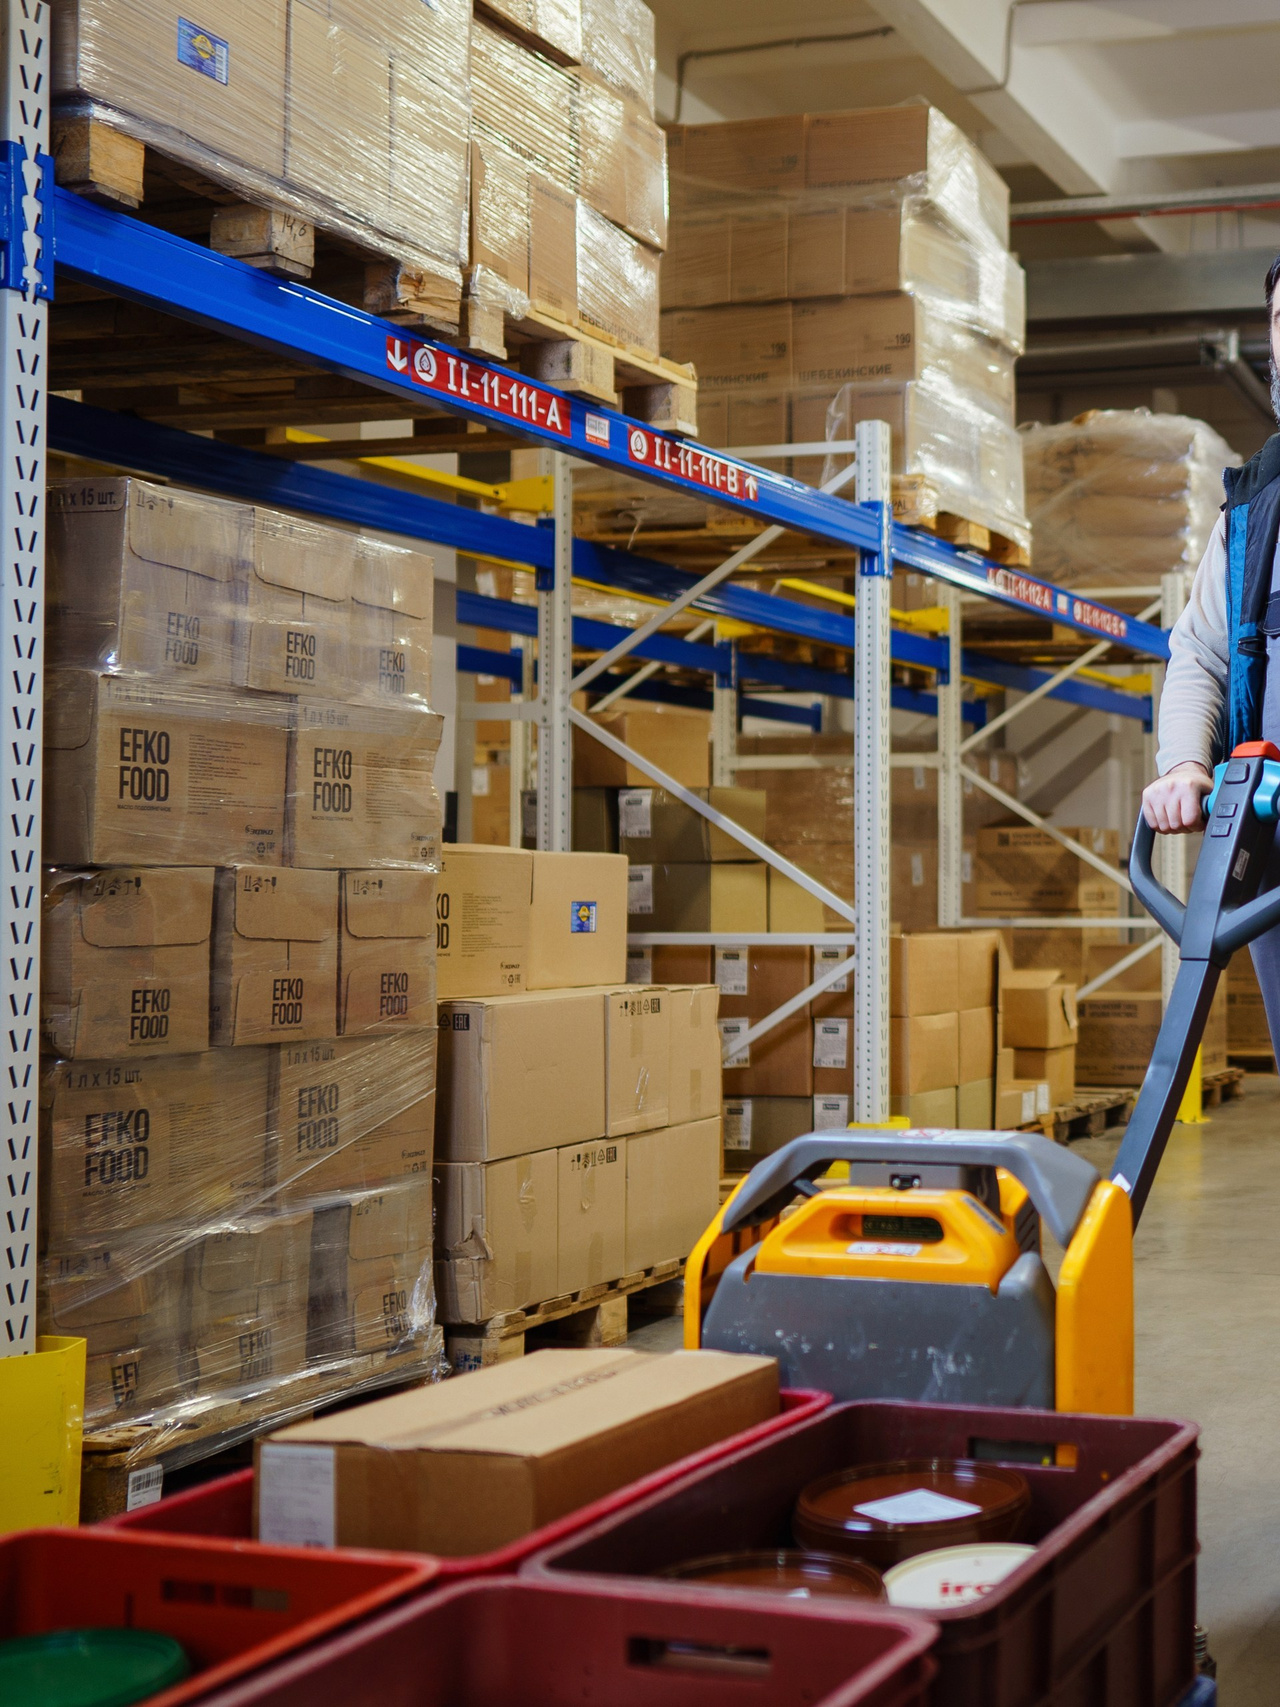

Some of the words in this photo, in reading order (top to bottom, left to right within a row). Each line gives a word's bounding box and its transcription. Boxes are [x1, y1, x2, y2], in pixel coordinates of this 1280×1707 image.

[80, 488, 94, 506] 15
[286, 631, 317, 657] EFKO
[284, 656, 316, 681] FOOD
[119, 728, 170, 765] EFKO
[314, 747, 353, 780] EFKO
[119, 765, 170, 802] FOOD
[313, 782, 352, 813] FOOD
[272, 978, 304, 1001] EFKO
[381, 972, 408, 994] EFKO
[131, 988, 171, 1014] EFKO
[271, 1002, 303, 1025] FOOD
[379, 995, 408, 1016] FOOD
[130, 1015, 169, 1040] FOOD
[454, 1014, 469, 1031] EAC
[311, 1046, 320, 1062] 15
[65, 1071, 73, 1088] 1
[78, 1075, 87, 1088] л
[105, 1067, 121, 1085] 15
[124, 1069, 143, 1083] шт.
[298, 1083, 340, 1119] EFKO
[85, 1108, 150, 1149] EFKO
[297, 1117, 339, 1153] FOOD
[84, 1146, 149, 1187] FOOD
[382, 1289, 407, 1315] EFKO
